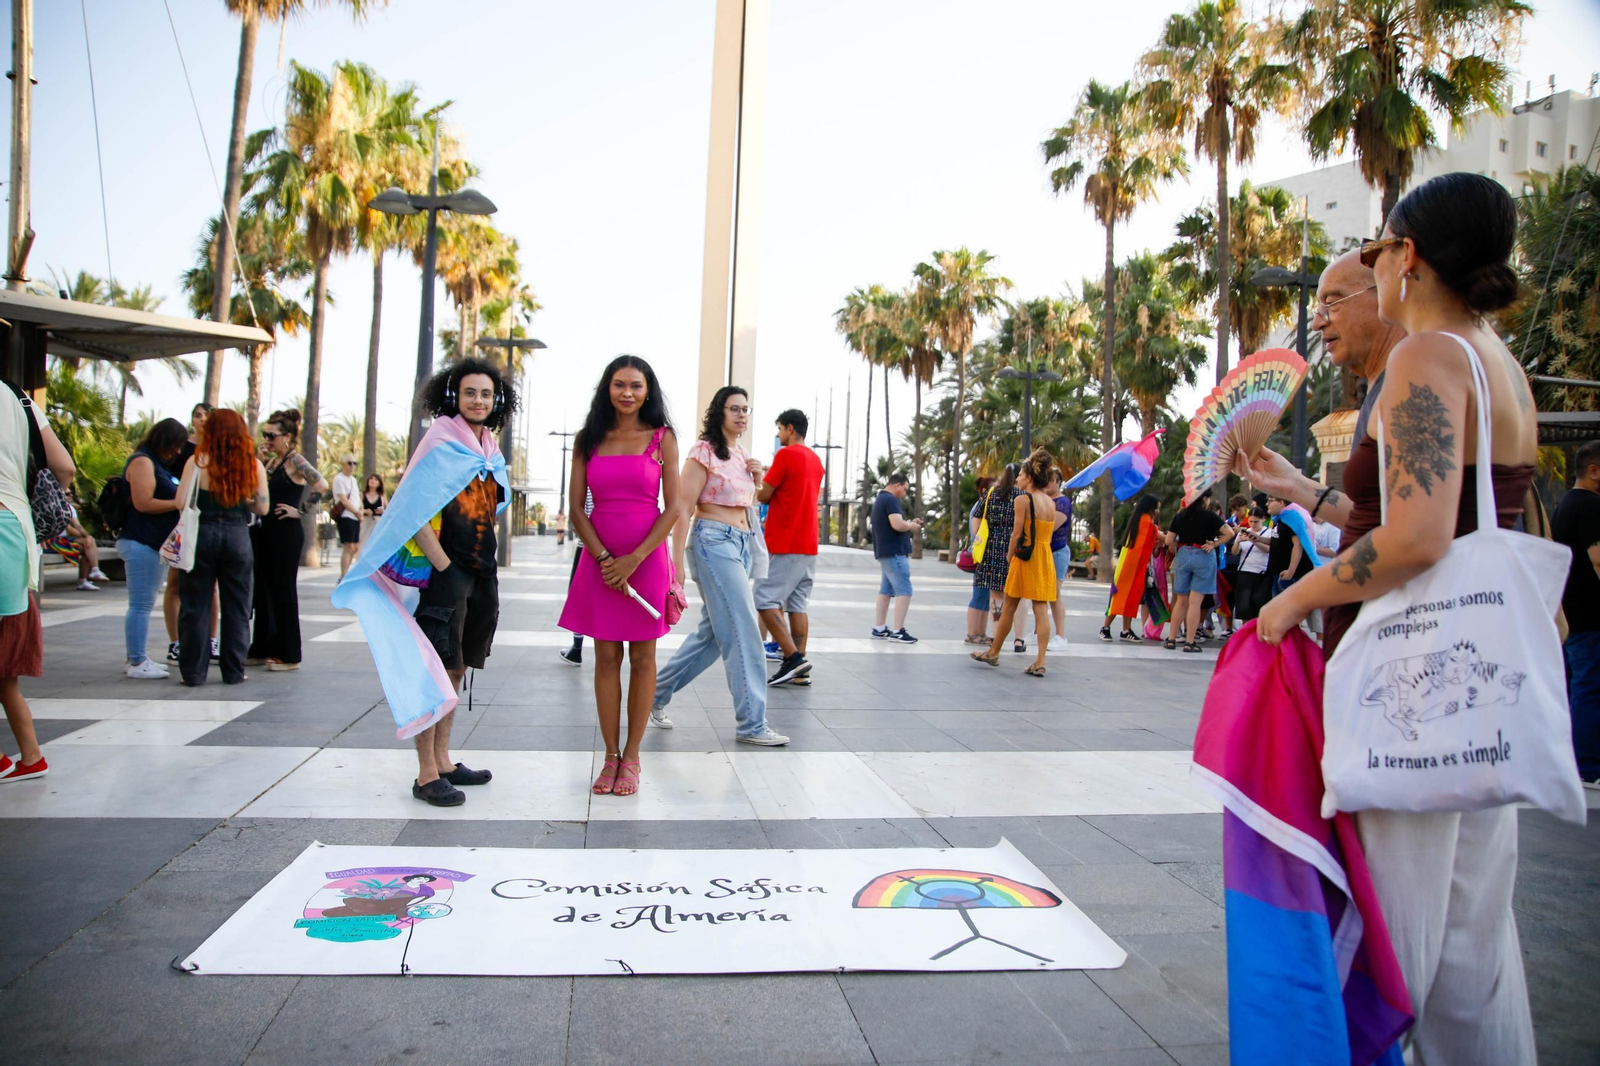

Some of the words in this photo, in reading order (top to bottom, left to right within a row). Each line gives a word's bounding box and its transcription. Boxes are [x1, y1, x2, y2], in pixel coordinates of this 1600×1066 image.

[1406, 598, 1456, 619] personas
[1459, 590, 1504, 607] somos
[1378, 618, 1438, 640] complejas
[1367, 747, 1379, 769] la
[1384, 753, 1438, 769] ternura
[1442, 753, 1457, 766] es
[1462, 728, 1511, 766] simple
[329, 868, 376, 879] IGUALDAD
[491, 878, 694, 900] Comisión
[704, 878, 829, 900] Sáfica
[552, 906, 603, 924] de
[610, 904, 793, 934] Almería
